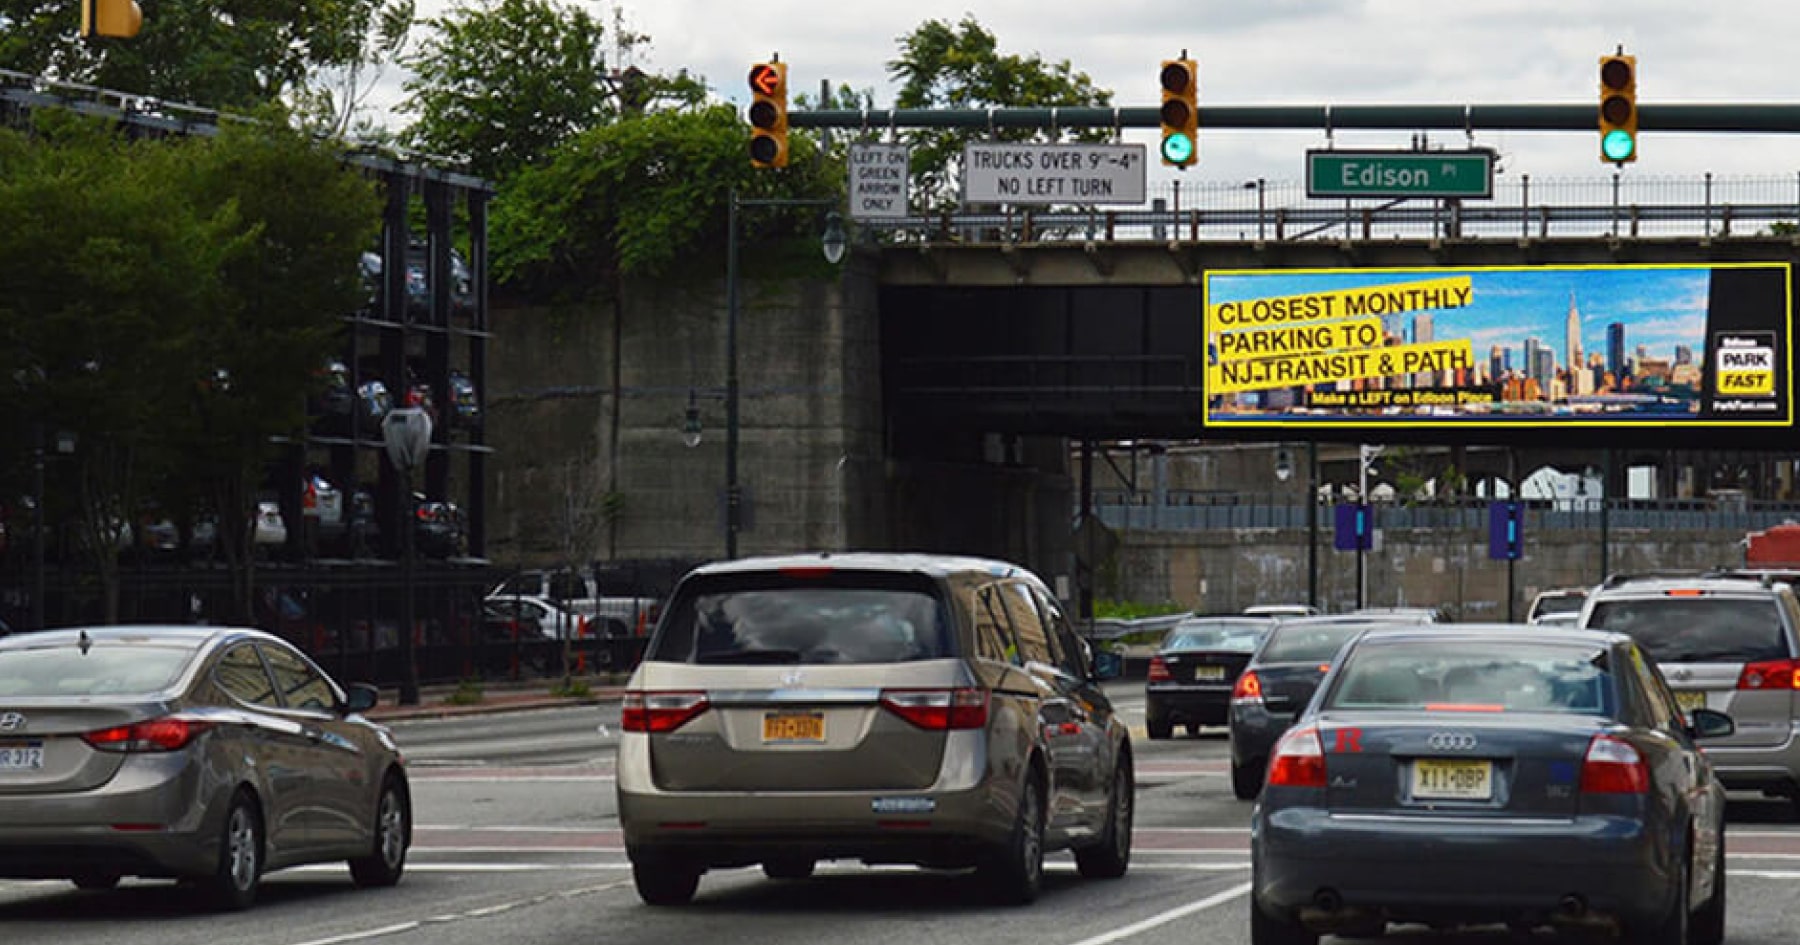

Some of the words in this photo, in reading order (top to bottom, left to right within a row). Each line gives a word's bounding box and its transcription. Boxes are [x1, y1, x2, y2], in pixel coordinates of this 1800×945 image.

[854, 151, 882, 164] LEFT
[886, 151, 905, 165] ON
[973, 151, 1033, 170] TRUCKS
[1041, 151, 1082, 170] OVER
[858, 167, 899, 179] GREEN
[1341, 162, 1429, 187] Edison
[858, 182, 899, 195] ARROW
[997, 177, 1020, 195] NO
[1027, 177, 1064, 195] LEFT
[1071, 177, 1113, 196] TURN
[862, 197, 894, 210] ONLY
[1217, 295, 1337, 326] CLOSEST
[1345, 285, 1471, 316] MONTHLY
[1219, 326, 1333, 355] PARKING
[1342, 323, 1378, 346] TO
[1378, 352, 1394, 375] &
[1403, 349, 1469, 373] PATH
[1723, 352, 1769, 367] PARK
[1723, 373, 1767, 388] FAST
[1312, 391, 1346, 404] Make
[1359, 390, 1392, 404] LEFT
[1393, 393, 1410, 404] on
[1413, 391, 1455, 404] Edison
[1457, 391, 1494, 404] Place
[1334, 727, 1365, 753] R
